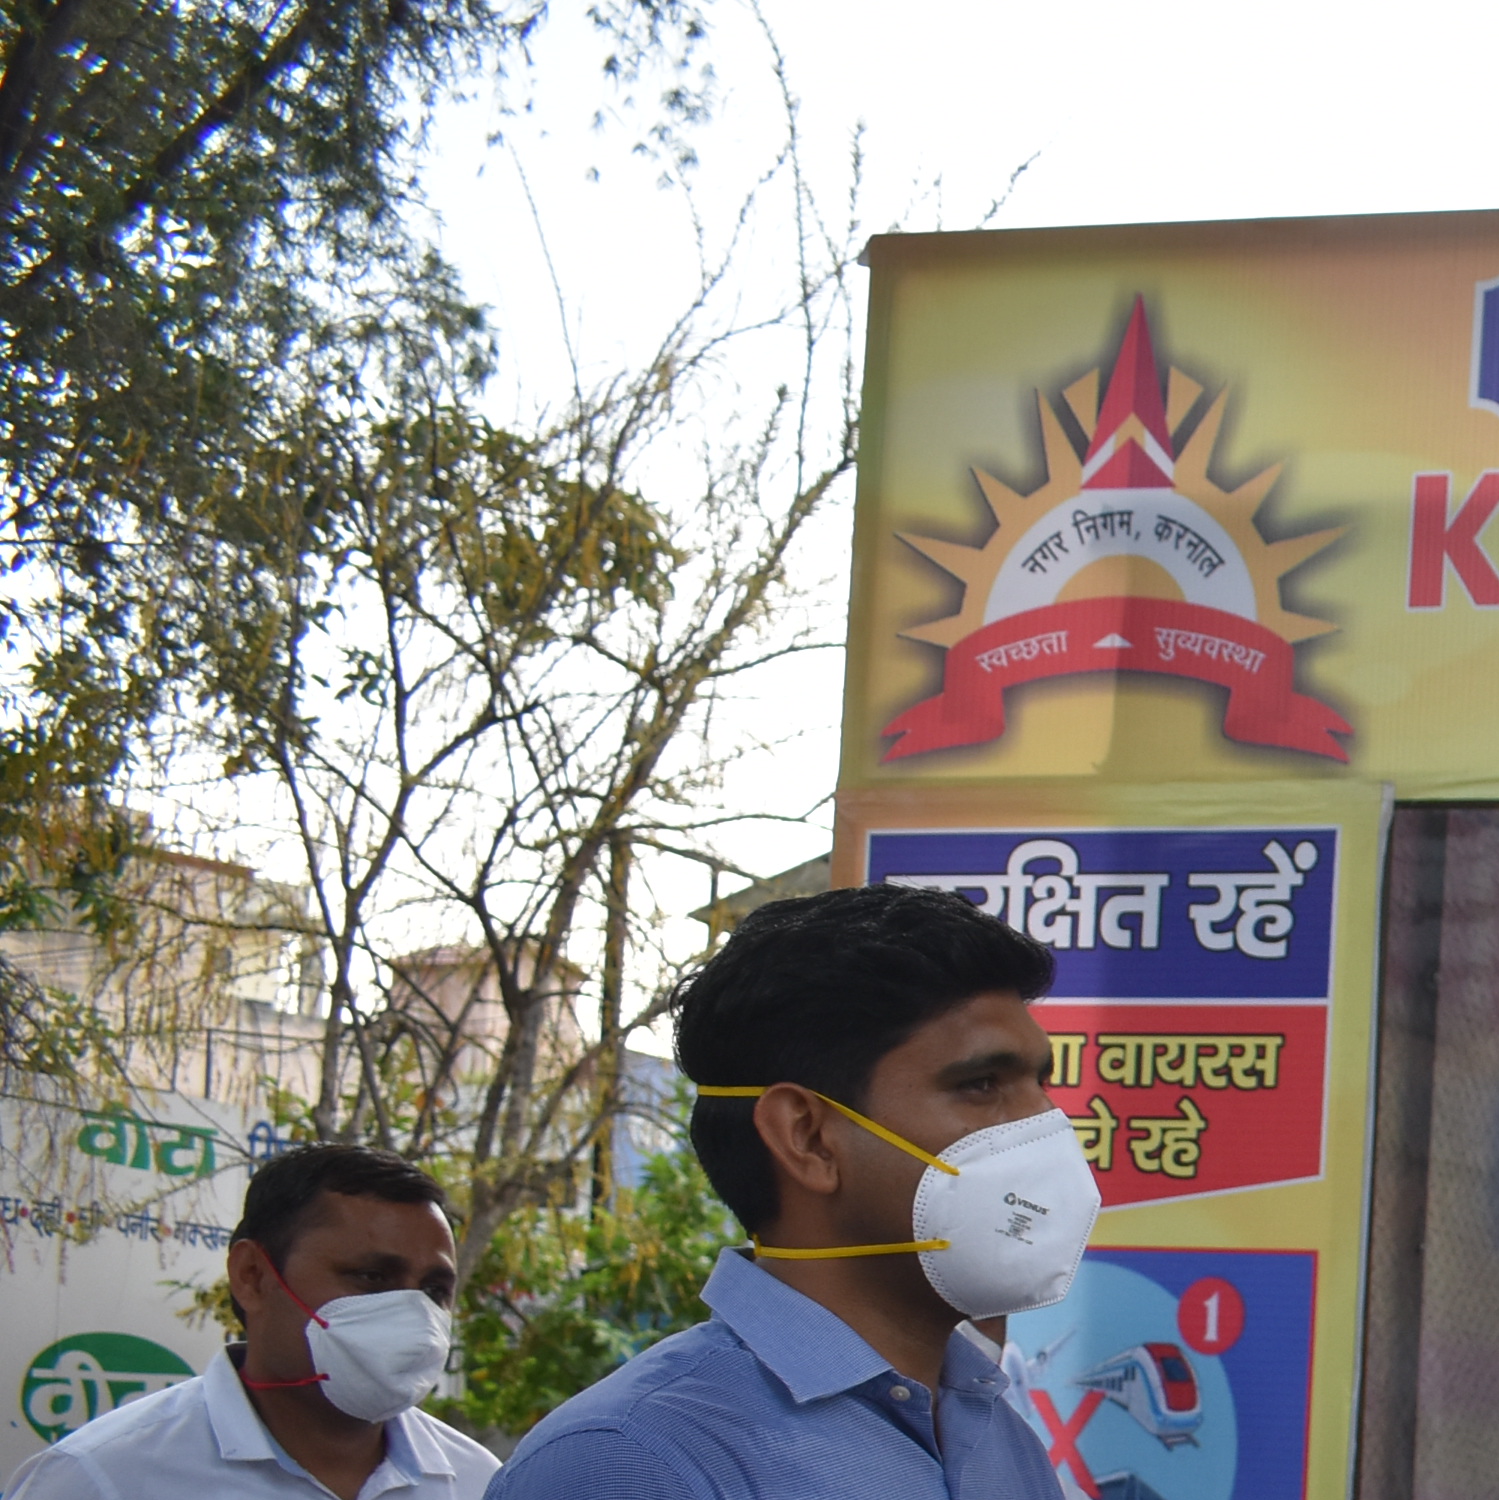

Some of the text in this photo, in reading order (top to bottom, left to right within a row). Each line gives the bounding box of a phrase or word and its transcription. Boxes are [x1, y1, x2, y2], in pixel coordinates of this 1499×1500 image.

[1021, 526, 1068, 579] नगर
[1153, 515, 1227, 580] करनाल
[975, 627, 1268, 677] स्वच्छता सुव्यवस्था
[1188, 840, 1318, 958] रहें
[1097, 1033, 1285, 1090] वायरस
[1129, 1098, 1208, 1179] रहे
[1201, 1291, 1221, 1342] 1
